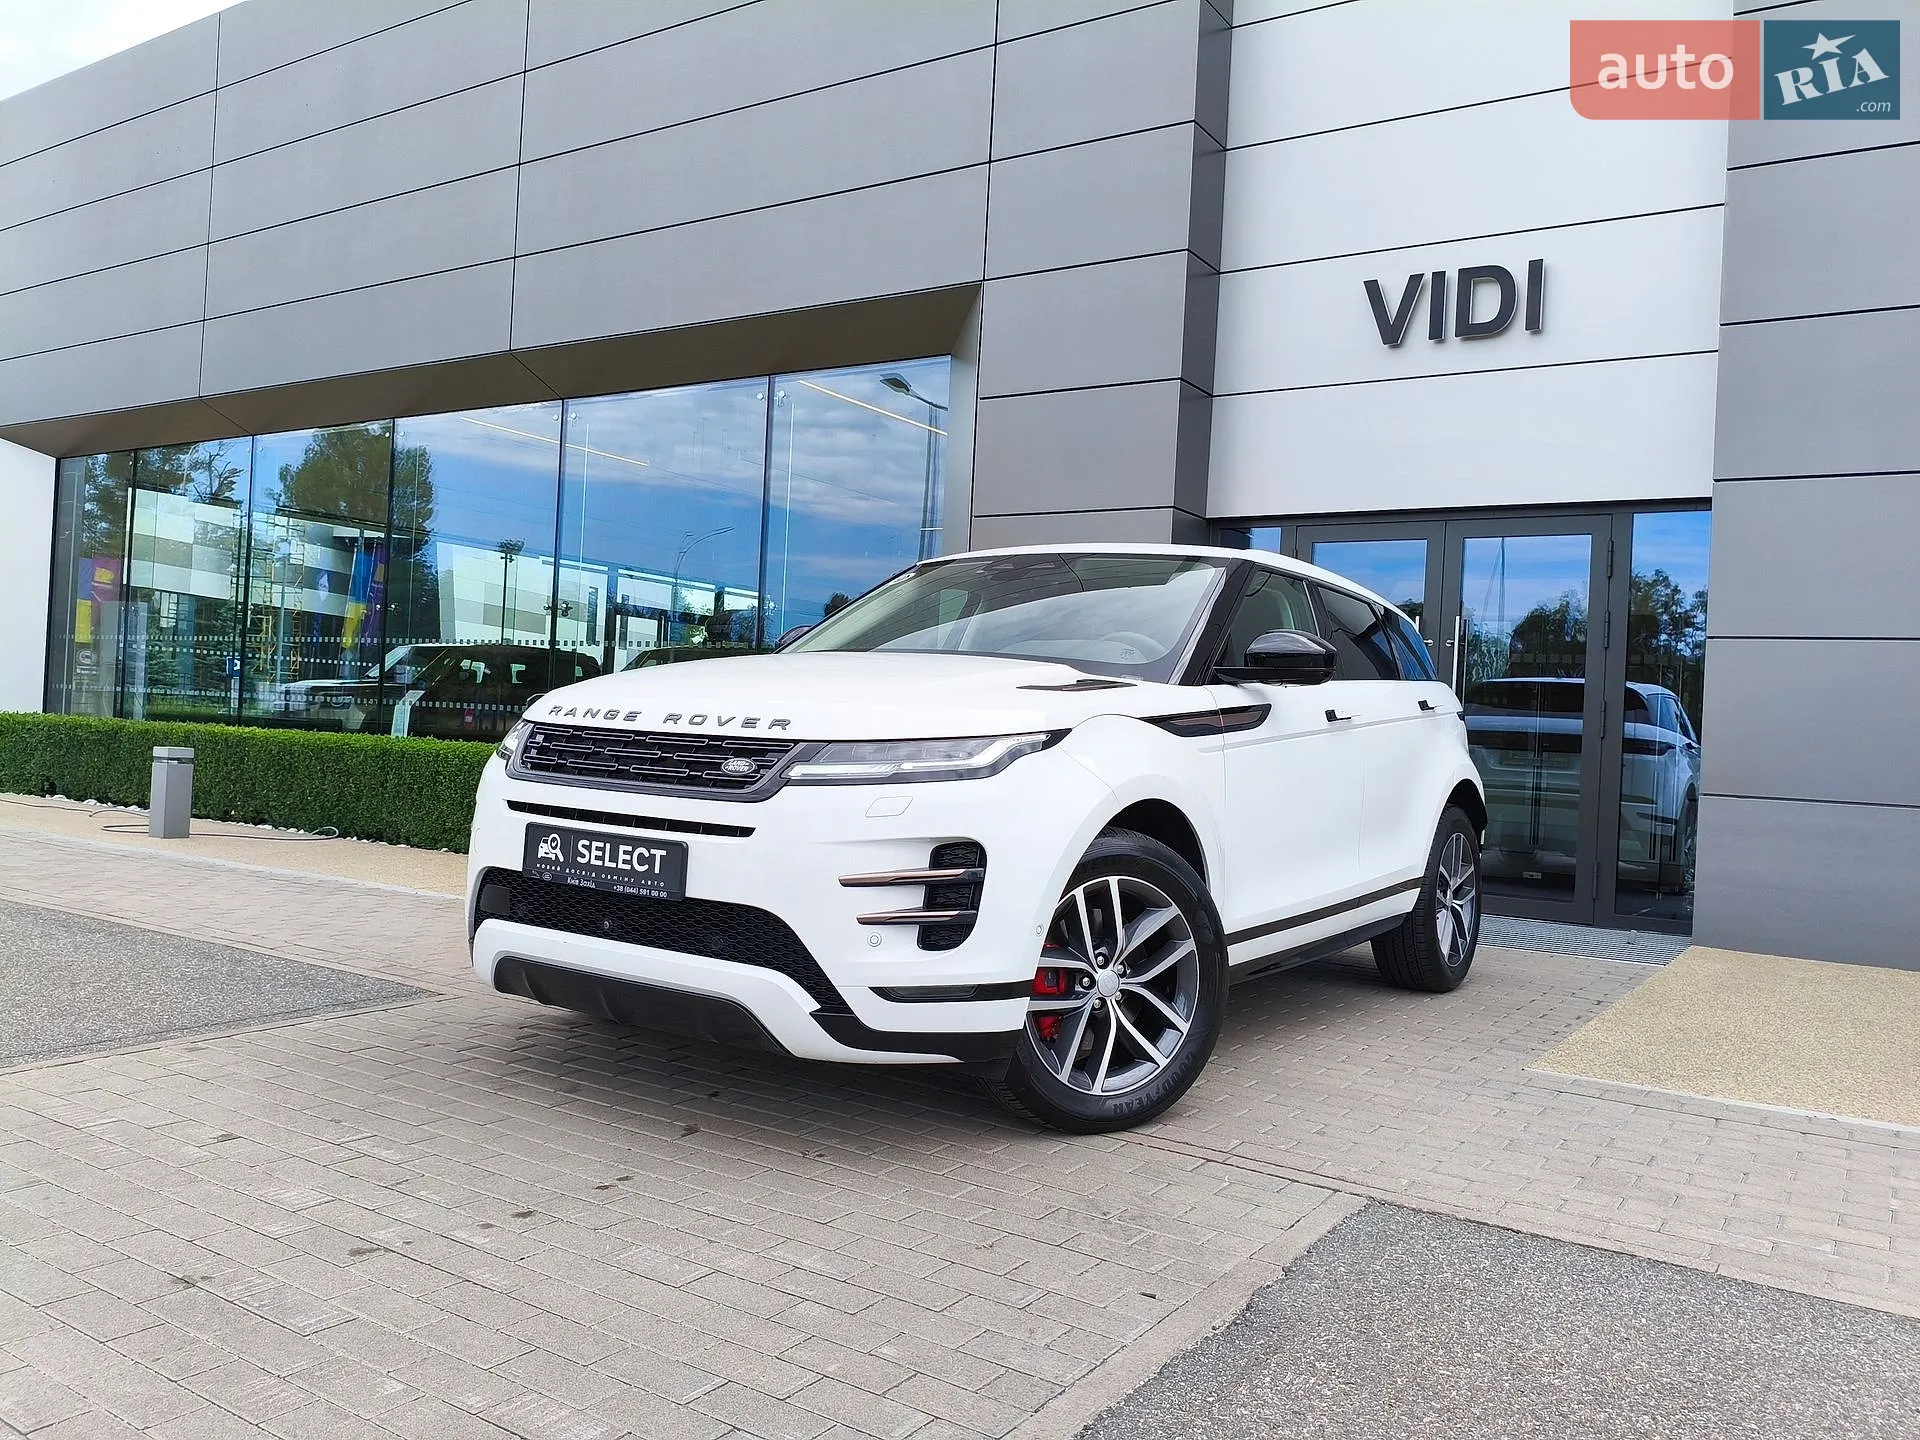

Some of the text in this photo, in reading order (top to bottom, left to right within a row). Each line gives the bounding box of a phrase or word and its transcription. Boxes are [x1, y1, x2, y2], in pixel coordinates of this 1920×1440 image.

[1362, 258, 1545, 347] VIDI
[548, 705, 792, 731] RANGE ROVER
[576, 839, 667, 874] SELECT
